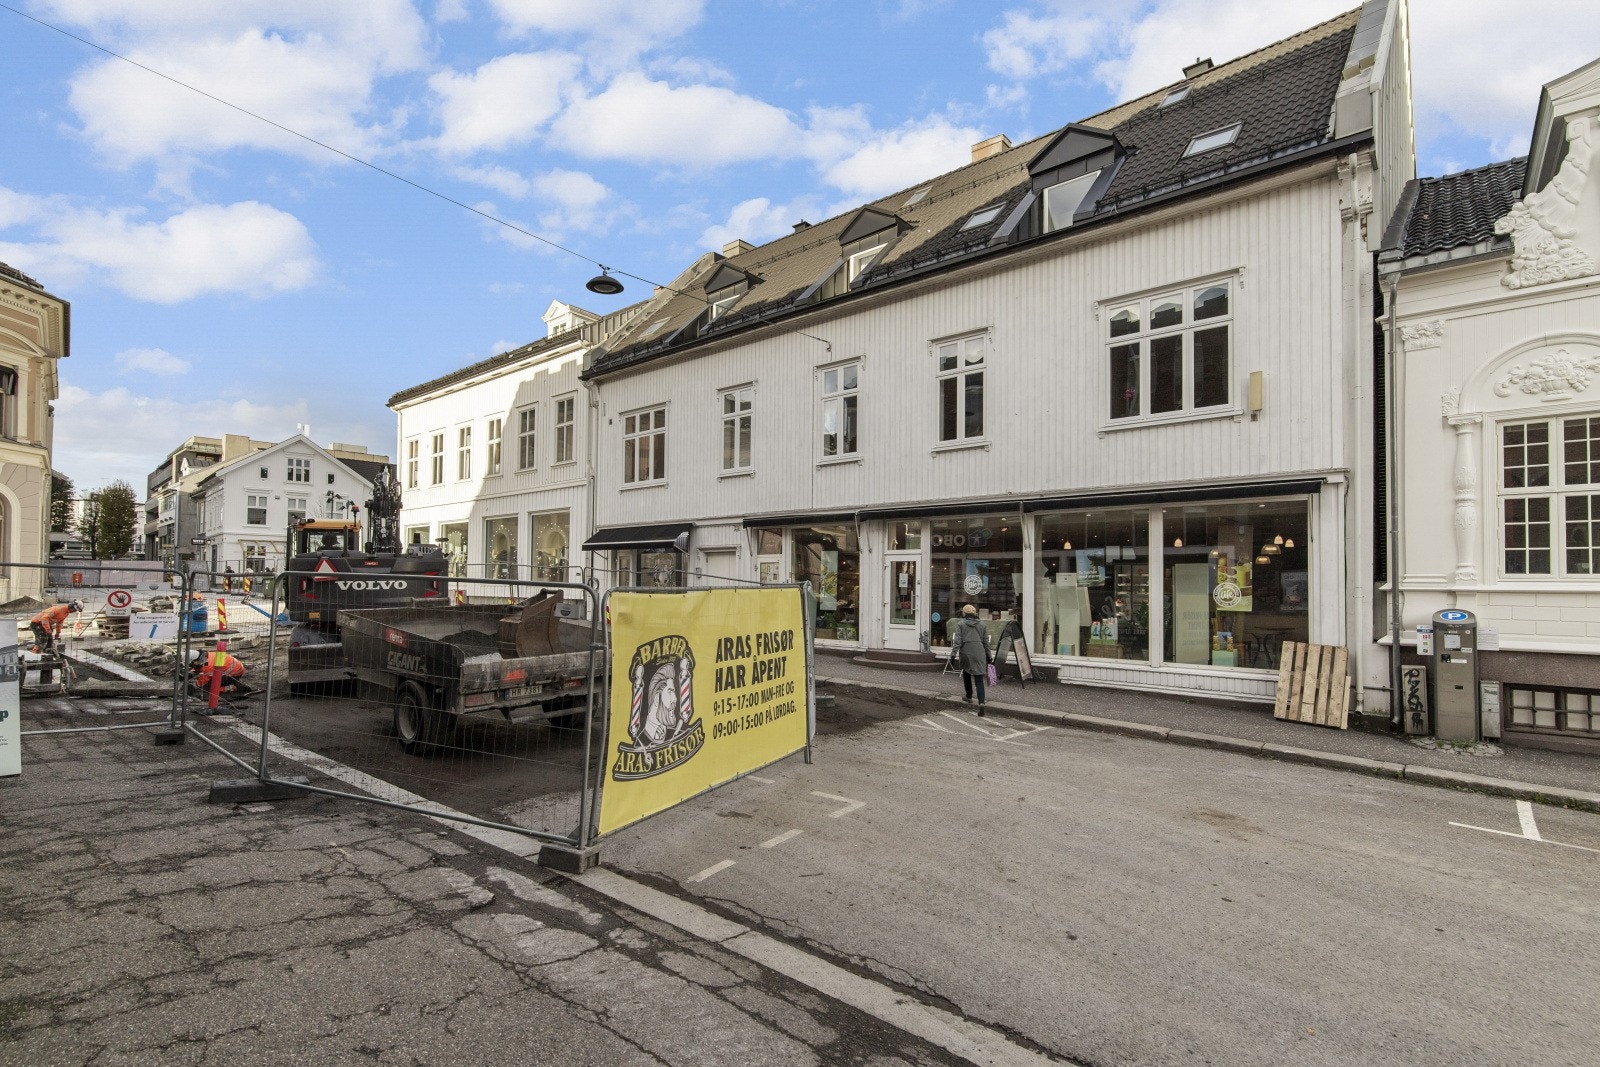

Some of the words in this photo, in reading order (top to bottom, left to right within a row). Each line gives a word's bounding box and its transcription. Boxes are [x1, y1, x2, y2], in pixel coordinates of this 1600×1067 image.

[335, 580, 408, 591] VOLVO
[1448, 612, 1461, 620] P
[388, 651, 421, 672] GIGANT
[640, 637, 686, 665] BARBER
[715, 634, 752, 664] ARAS
[756, 629, 794, 656] FRISØR
[715, 664, 746, 694] HAR
[751, 655, 787, 686] ÅPENT
[511, 689, 522, 697] HR
[524, 686, 540, 695] 7381
[713, 691, 759, 717] 9:15-17:00
[760, 683, 785, 705] MAN-FRE
[785, 680, 795, 695] OG
[712, 711, 764, 740] 09:00-15:00
[765, 705, 774, 724] PÅ
[773, 700, 797, 721] LØRDAG.
[615, 751, 653, 773] ARAS
[655, 727, 704, 770] FRISØR
